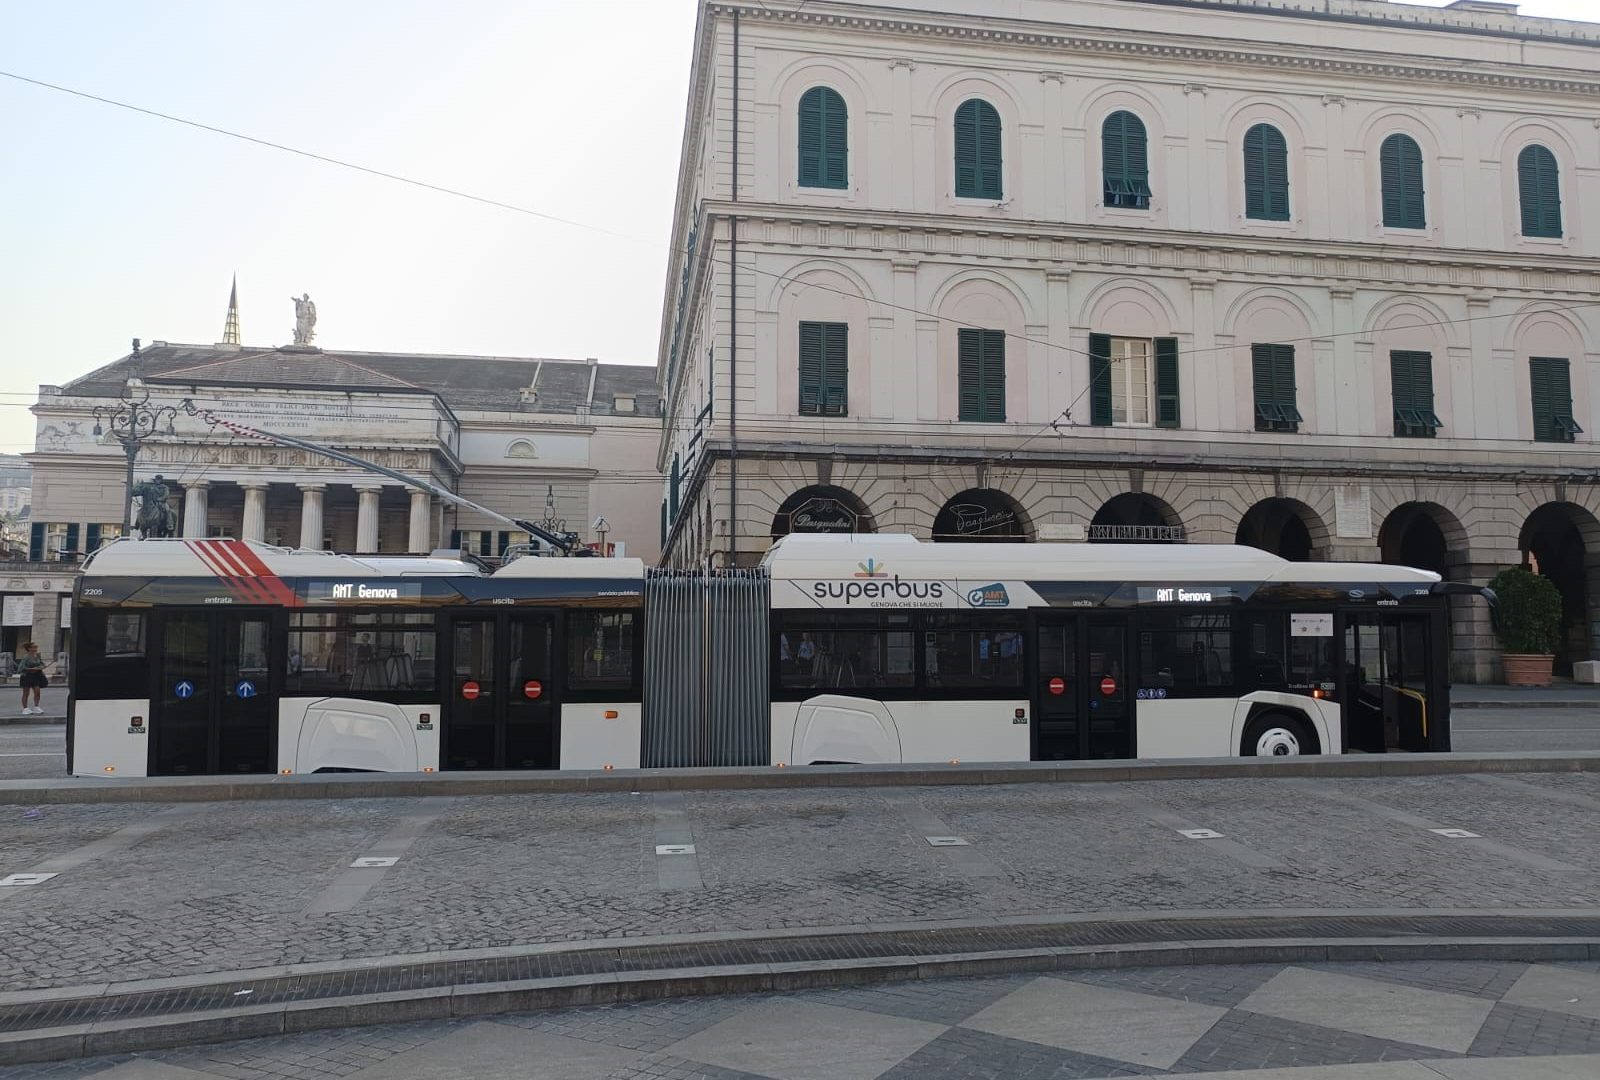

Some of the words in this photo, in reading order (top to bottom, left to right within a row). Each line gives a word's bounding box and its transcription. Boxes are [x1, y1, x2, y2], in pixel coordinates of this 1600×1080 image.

[333, 583, 353, 598] AMT
[358, 583, 398, 598] Genova
[814, 574, 943, 604] superbus
[1156, 588, 1174, 602] AMT
[1178, 588, 1212, 602] Genova
[492, 597, 515, 605] uscita
[1072, 599, 1093, 607] uscita
